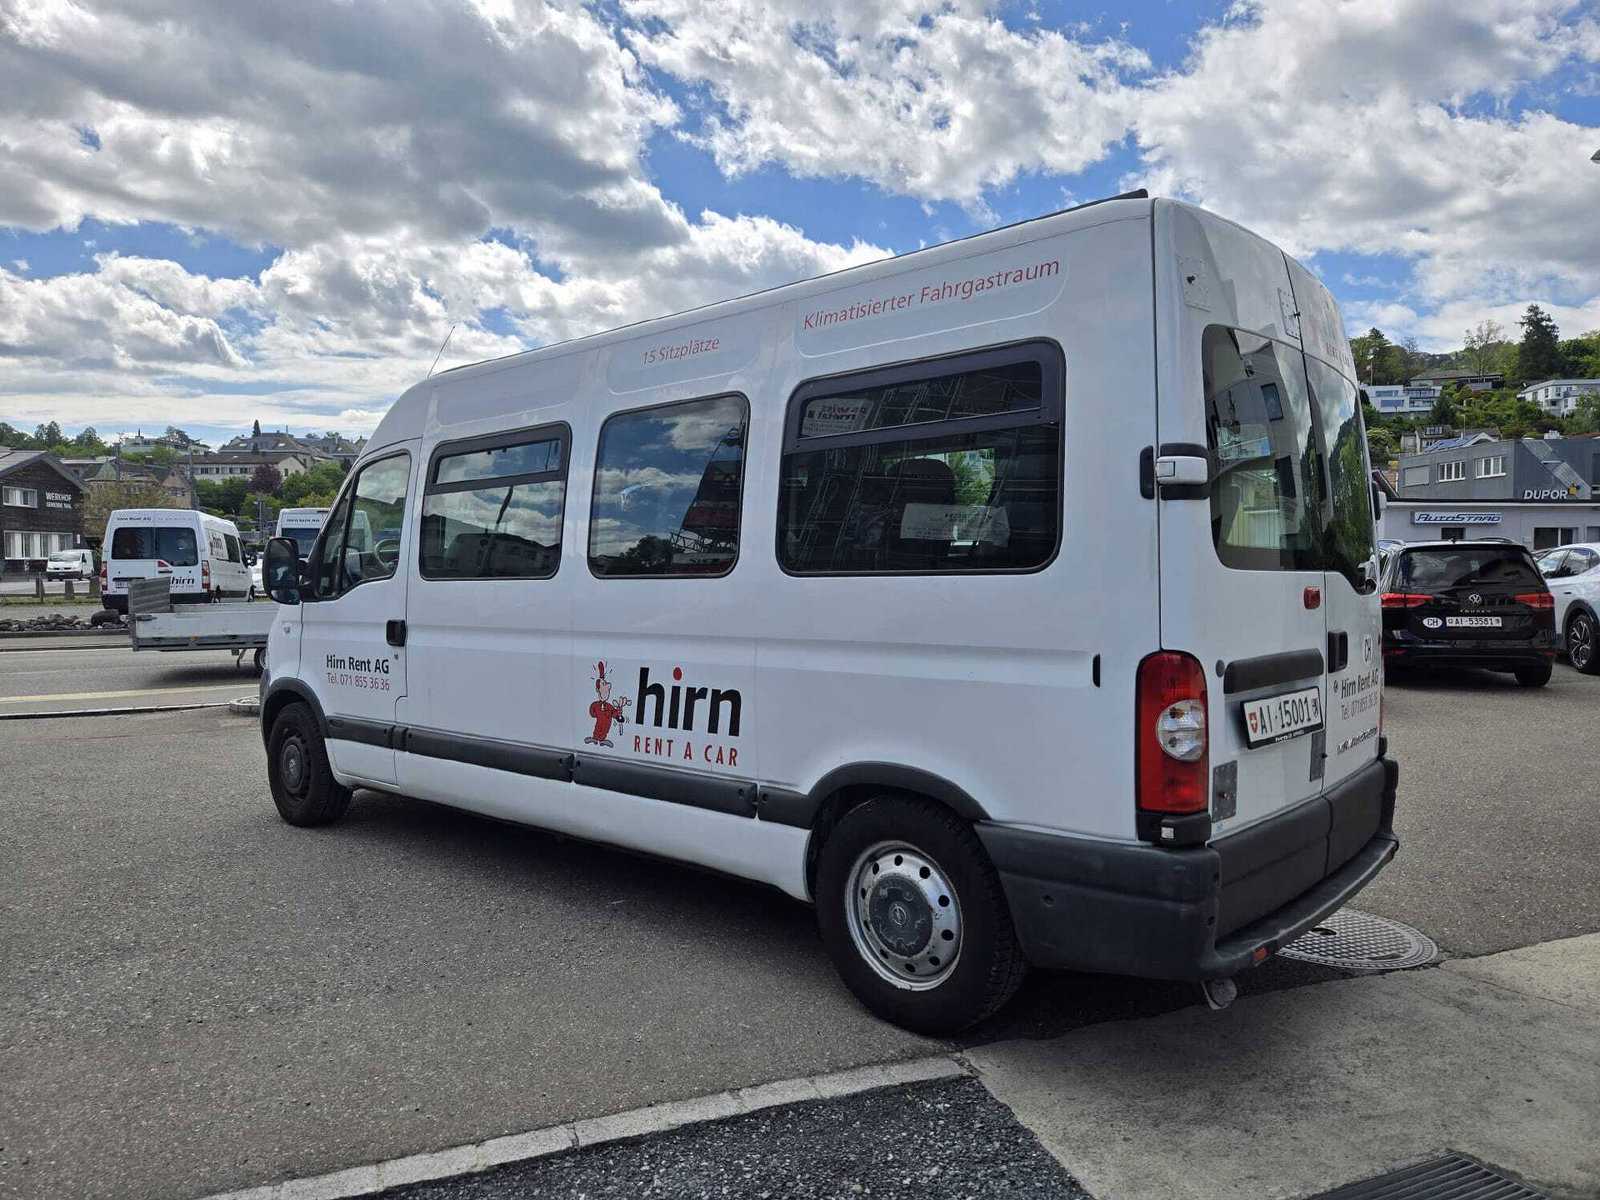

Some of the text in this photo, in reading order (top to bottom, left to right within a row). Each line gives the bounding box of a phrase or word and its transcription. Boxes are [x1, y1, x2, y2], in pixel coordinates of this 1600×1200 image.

[803, 260, 1060, 331] Klimatisierter Fahrgastraum
[643, 338, 720, 364] 15 Sitzplätze
[1524, 489, 1568, 500] DUPOR
[171, 576, 195, 585] hirn
[1427, 618, 1439, 626] CH
[326, 654, 389, 674] Hirn Rent AG
[340, 674, 353, 686] 071
[354, 675, 368, 688] 855
[369, 677, 379, 689] 36
[380, 678, 390, 692] 36
[1341, 668, 1379, 699] Hirn Rent AG
[635, 666, 742, 737] hirn
[633, 735, 738, 766] RENT A CAR
